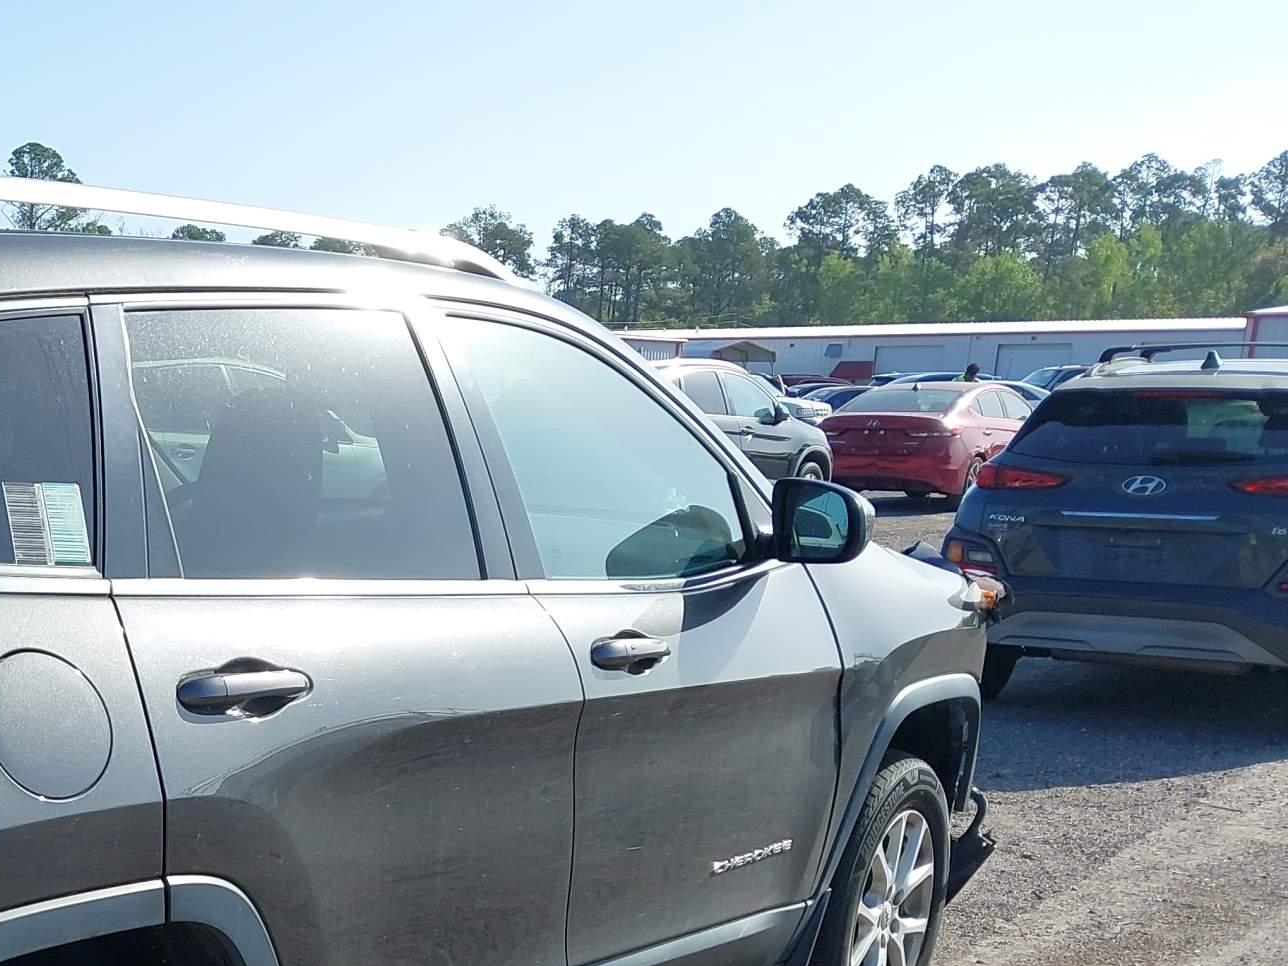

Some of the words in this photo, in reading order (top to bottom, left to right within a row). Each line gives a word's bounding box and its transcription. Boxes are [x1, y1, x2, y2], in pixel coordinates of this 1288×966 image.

[988, 513, 1025, 523] KONA
[860, 780, 905, 859] BRIDGESTONE
[711, 839, 793, 874] CHEROKEE
